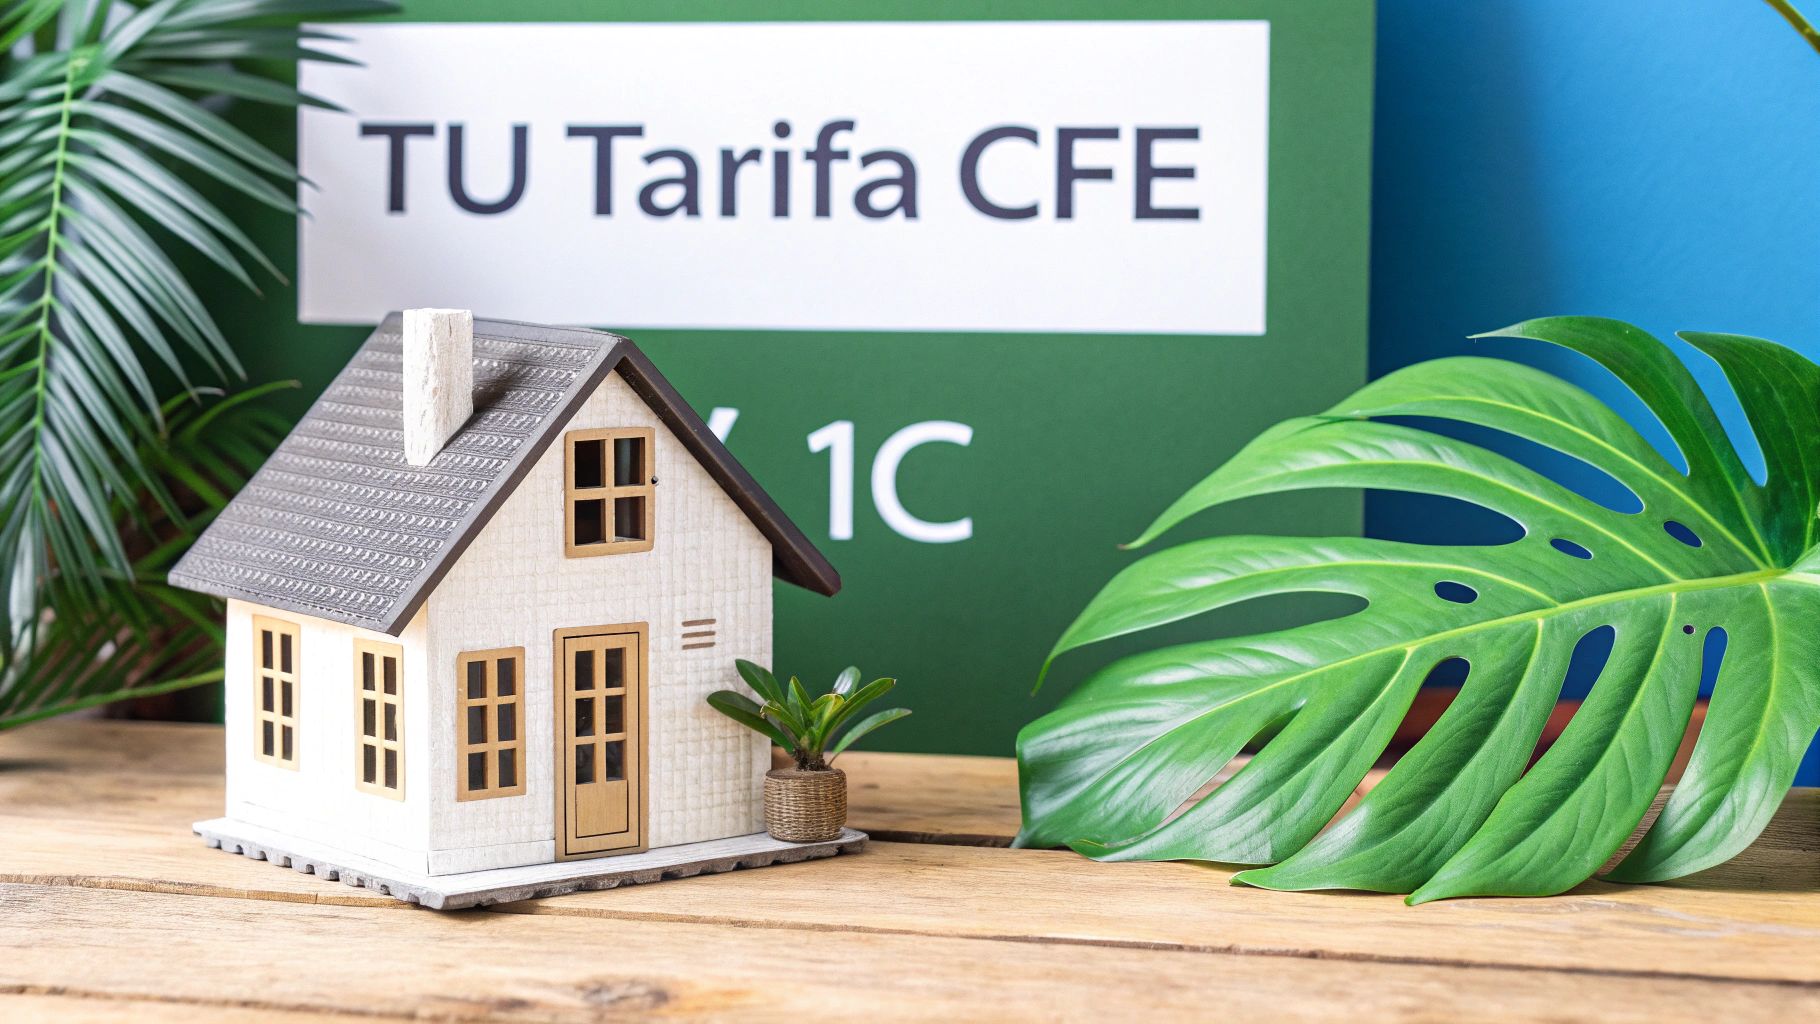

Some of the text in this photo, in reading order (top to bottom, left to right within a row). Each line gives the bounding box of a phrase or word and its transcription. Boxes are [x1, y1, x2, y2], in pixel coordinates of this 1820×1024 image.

[359, 119, 1201, 221] TU Tarifa CFE
[807, 420, 974, 544] 1C
